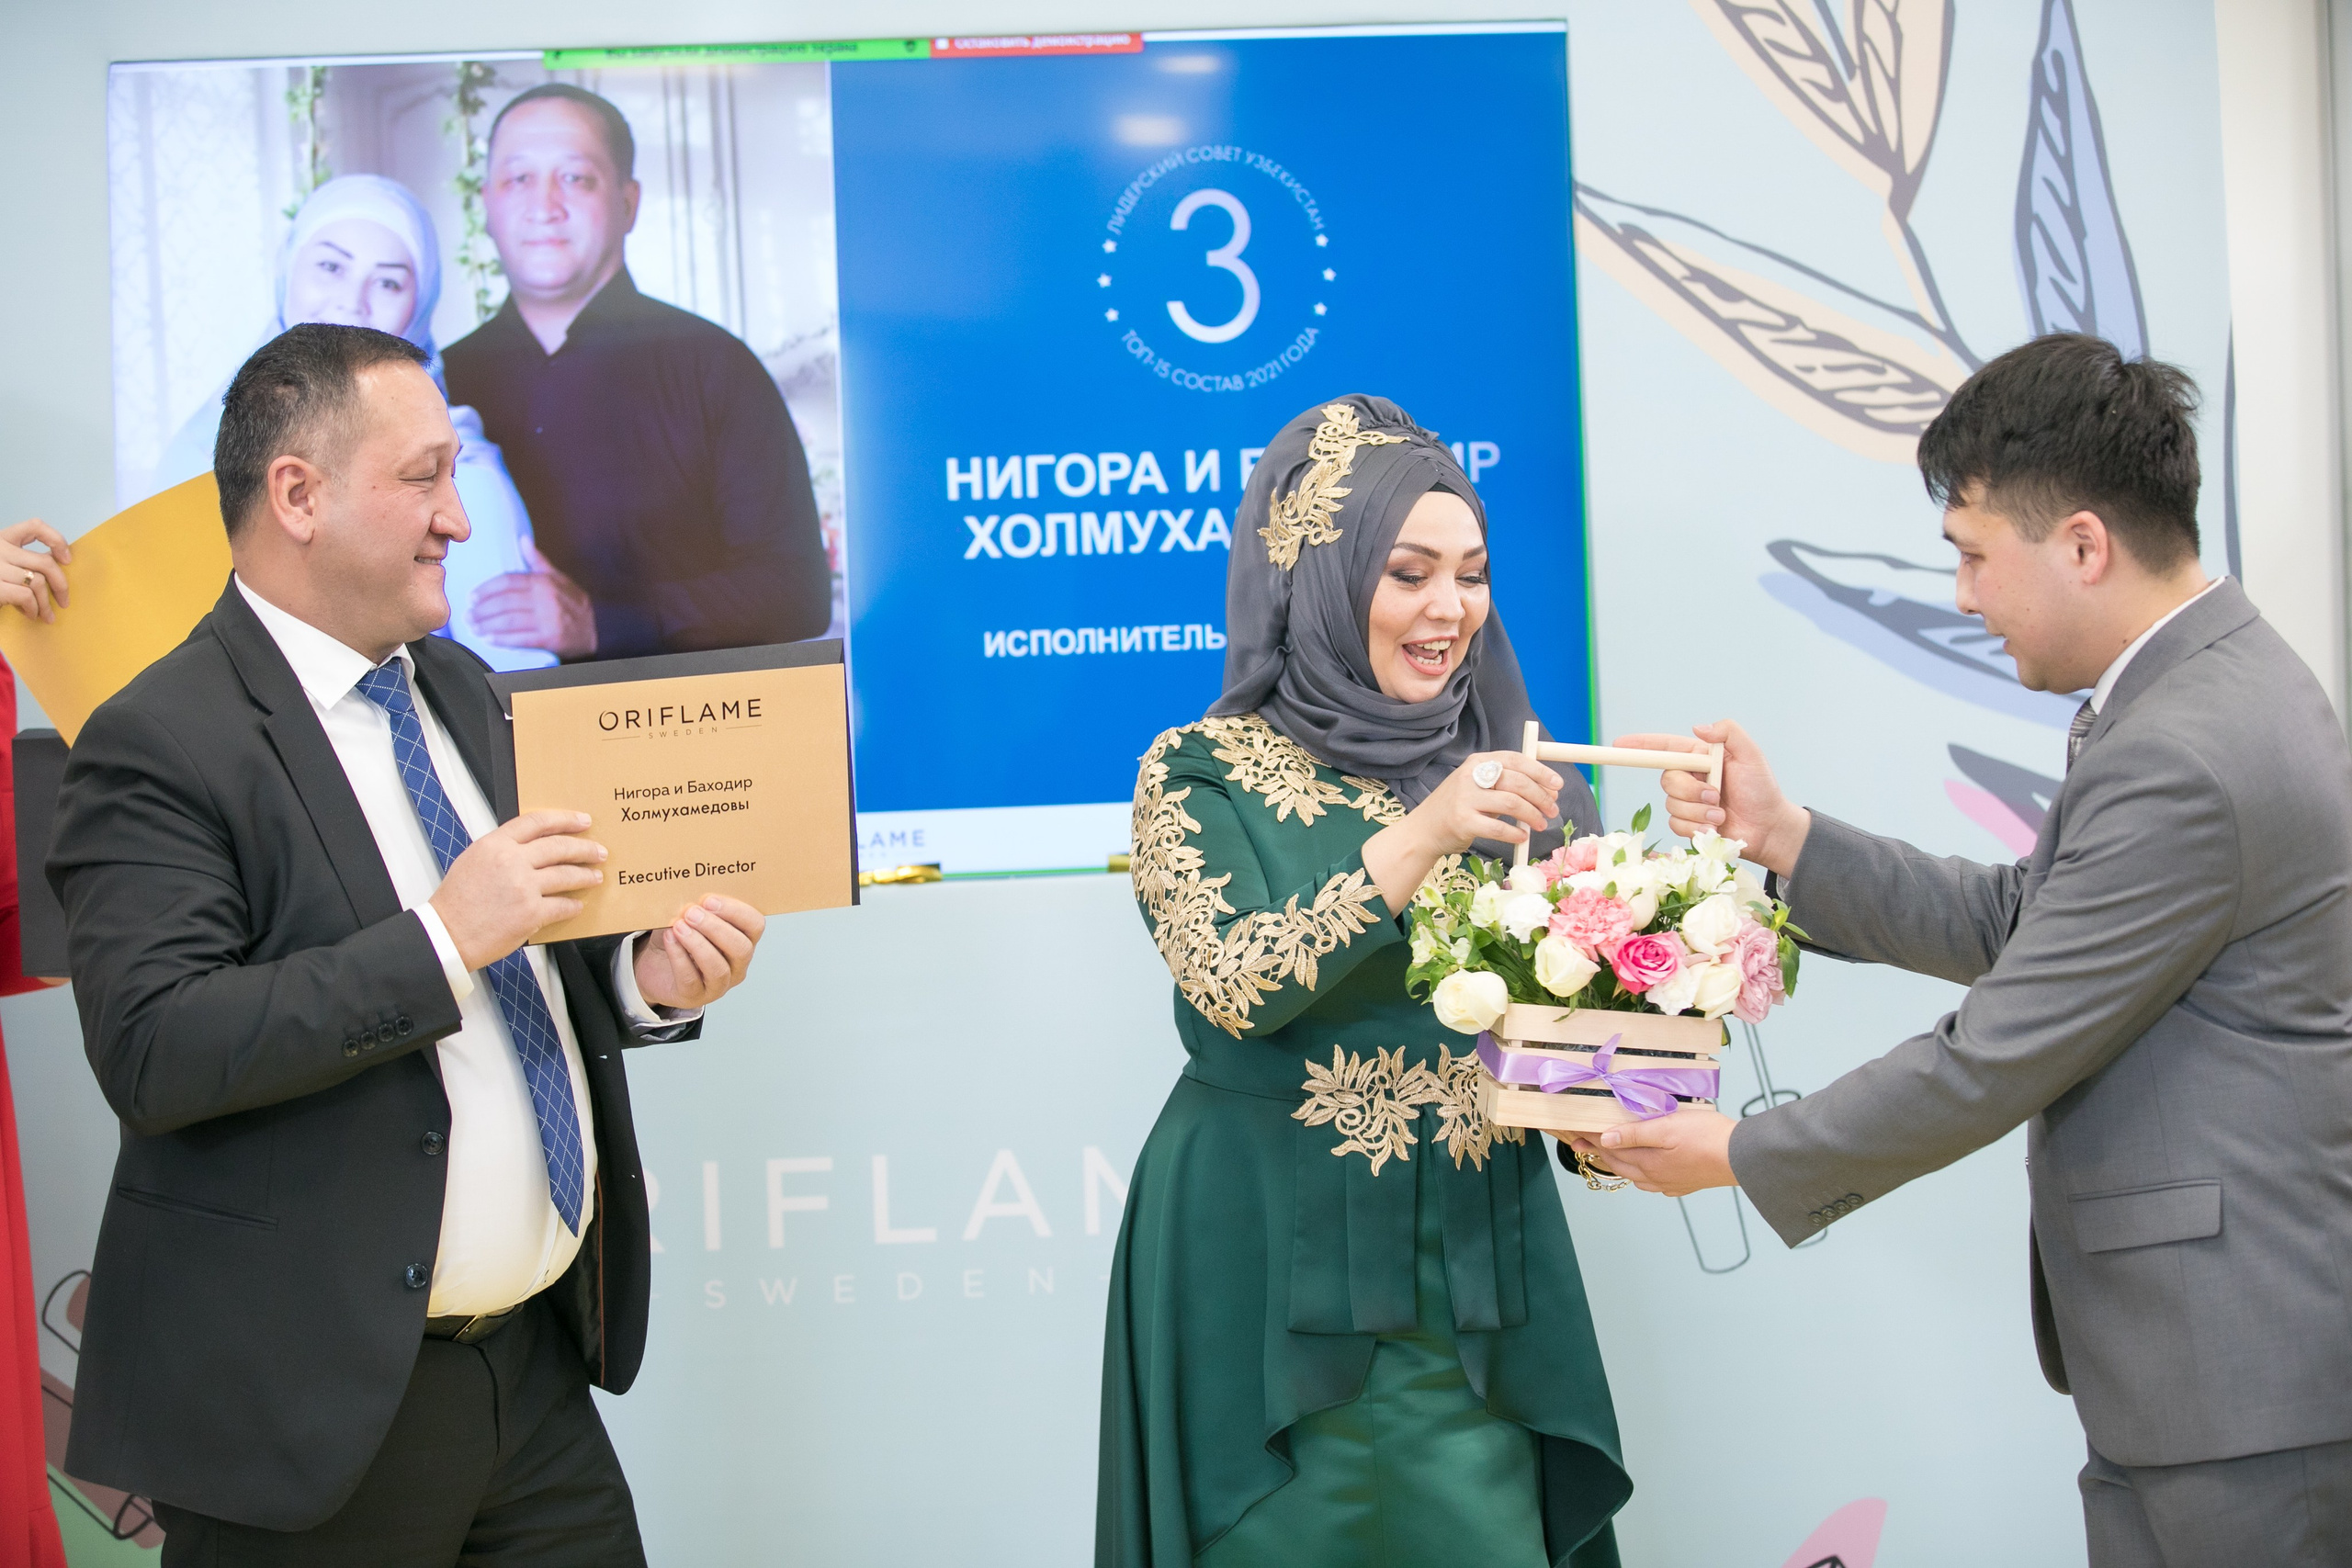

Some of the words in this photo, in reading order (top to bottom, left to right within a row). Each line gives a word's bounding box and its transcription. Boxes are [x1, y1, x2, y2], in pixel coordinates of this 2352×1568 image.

[1106, 151, 1185, 235] ЛИДЕРСКИЙ
[1185, 144, 1242, 164] СОВЕТ
[1245, 150, 1325, 231] УЗБЕКИСТАН
[1166, 187, 1261, 344] 3
[1121, 328, 1172, 378] ТОП-15
[1170, 367, 1245, 392] СОСТАВ
[1244, 356, 1283, 388] 2021
[1280, 326, 1319, 368] ГОДА
[945, 451, 1170, 502] НИГОРА
[1184, 448, 1221, 493] И
[963, 508, 1238, 560] ХОЛМУХА
[599, 698, 762, 731] ORIFLAME
[649, 727, 718, 739] SWEDEN
[614, 786, 670, 801] Нигора
[674, 785, 683, 795] и
[687, 778, 753, 794] Баходир
[621, 800, 749, 822] Холмухамедовы
[618, 866, 690, 886] Executive
[695, 861, 756, 877] Director
[704, 1267, 1056, 1309] SWEDEN
